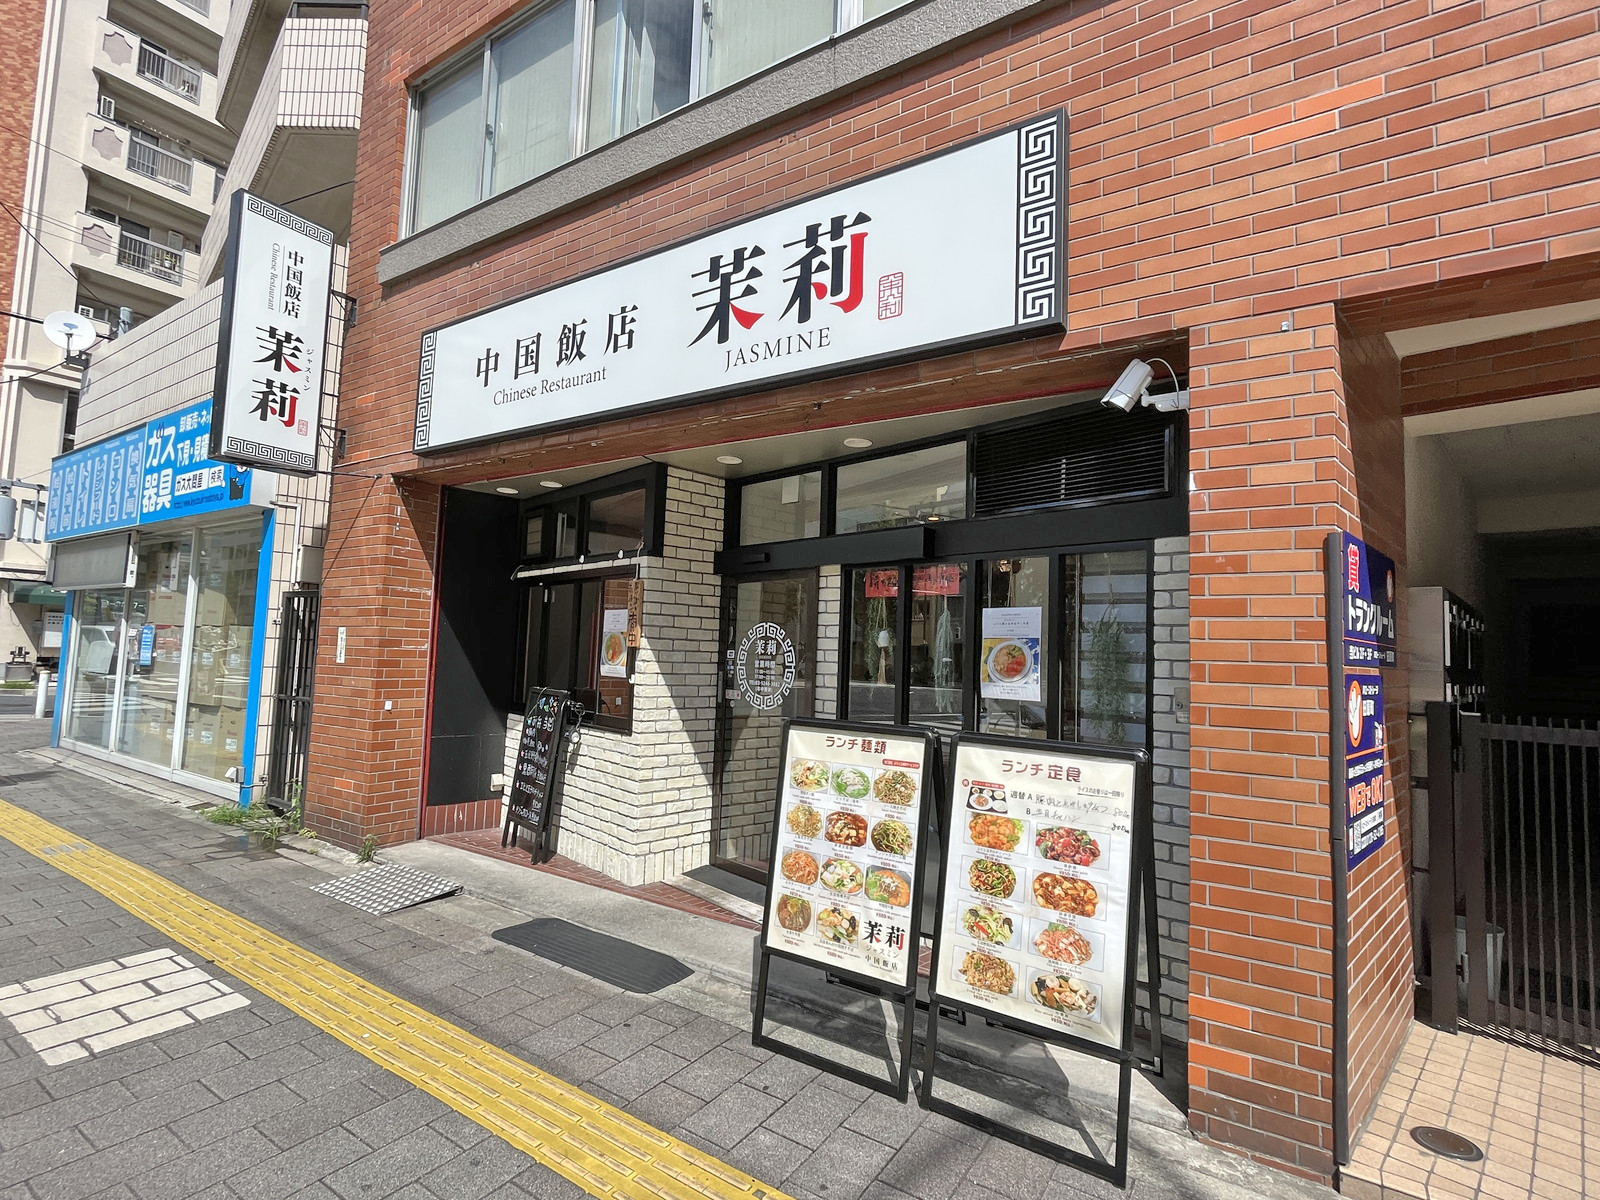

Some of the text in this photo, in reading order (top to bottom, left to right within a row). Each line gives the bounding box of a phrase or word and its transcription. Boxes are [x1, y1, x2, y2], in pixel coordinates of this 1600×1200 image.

[267, 242, 280, 311] Chinese Restaurant
[283, 251, 304, 319] 中国飯店
[687, 211, 871, 348] 茉莉
[475, 304, 639, 388] 中国飯店
[725, 326, 832, 373] JASMINE
[248, 325, 304, 428] 茉莉
[303, 348, 315, 391] ジャスミン
[493, 366, 607, 407] Chinese Restaurant
[146, 422, 176, 469] ガス
[142, 468, 173, 513] 器具
[1348, 594, 1395, 639] トランクルーム
[755, 639, 777, 655] 茉莉
[1001, 759, 1082, 783] ランチ定食
[862, 919, 905, 951] 茉莉
[865, 954, 898, 971] 中国飯店
